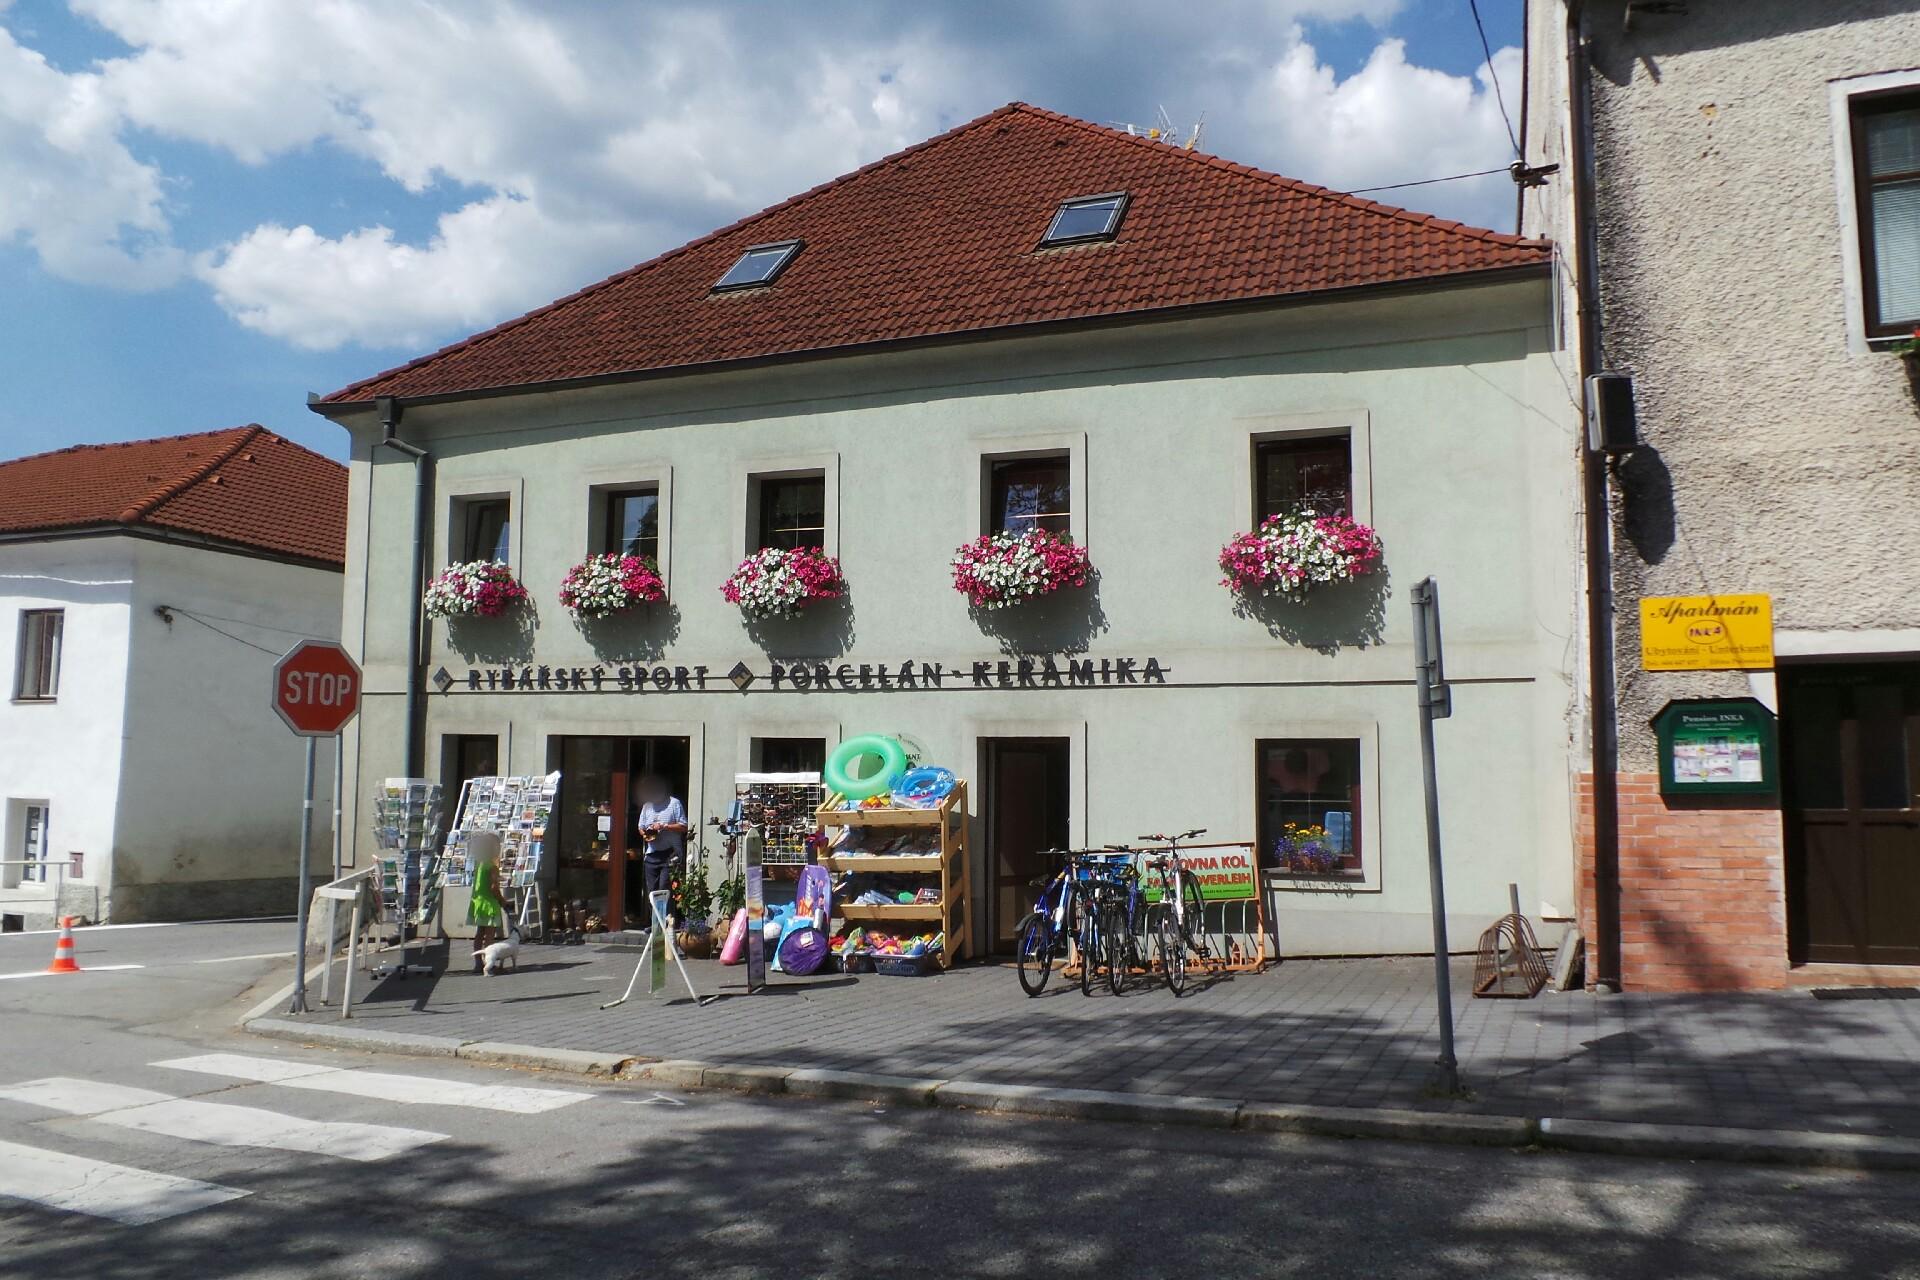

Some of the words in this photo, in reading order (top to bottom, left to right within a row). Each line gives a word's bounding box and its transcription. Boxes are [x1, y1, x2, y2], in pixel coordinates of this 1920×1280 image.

[1650, 600, 1759, 624] Apartmán
[468, 664, 605, 691] RYBÁŘSKÝ
[618, 665, 708, 692] SPORT
[771, 659, 942, 690] PORCELÁN
[972, 657, 1166, 688] KERAMIKA
[285, 670, 352, 706] STOP
[1145, 857, 1219, 873] POVNA
[1221, 855, 1250, 869] KOL
